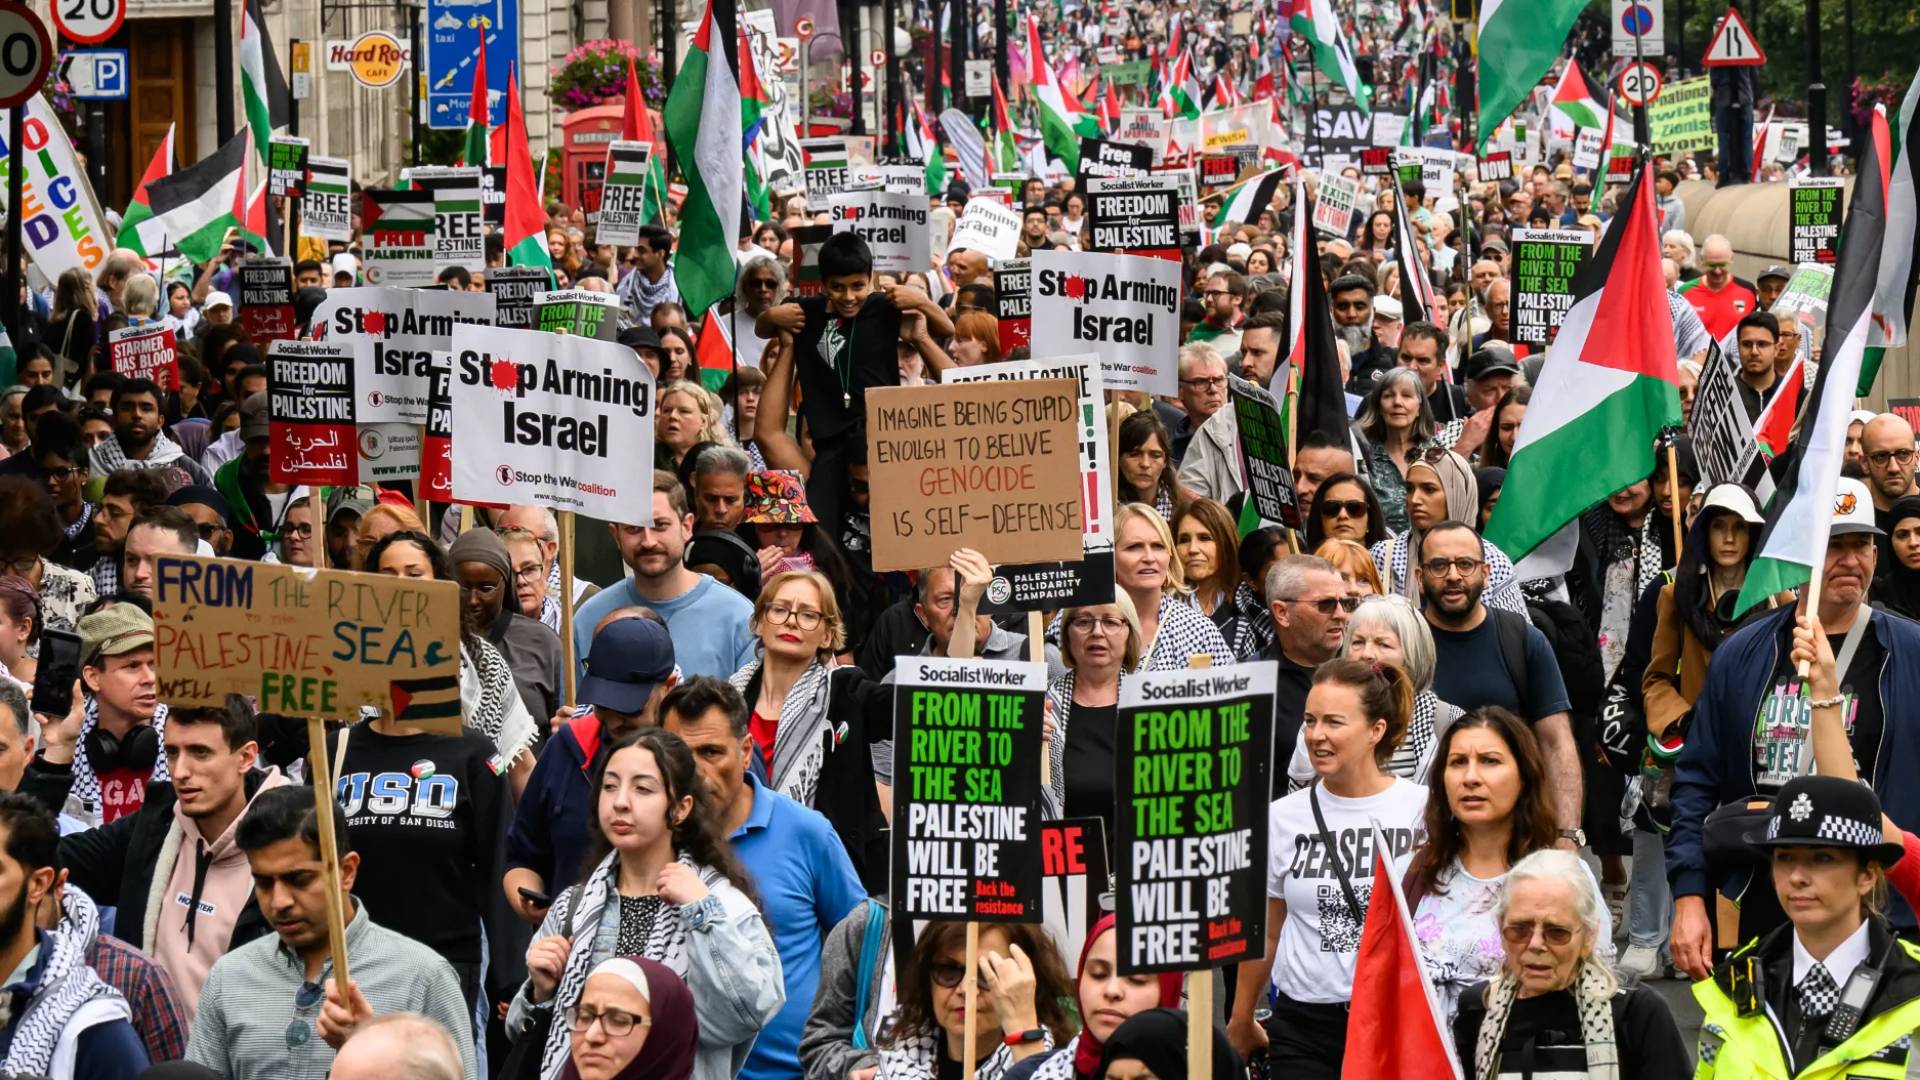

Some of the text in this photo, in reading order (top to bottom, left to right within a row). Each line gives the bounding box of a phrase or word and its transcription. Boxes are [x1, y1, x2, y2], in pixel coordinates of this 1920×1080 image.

[64, 0, 115, 20] 20
[434, 33, 455, 43] taxi
[330, 44, 411, 66] Hard Roc
[873, 51, 884, 65] D
[98, 61, 118, 88] P
[366, 68, 388, 77] CAFE
[1626, 75, 1656, 92] 20
[1312, 109, 1373, 139] SAV
[1206, 129, 1248, 147] JEWISH
[1100, 143, 1132, 163] Free
[1080, 157, 1148, 178] Palestine
[1204, 158, 1235, 175] FREE
[1479, 159, 1511, 181] NOW
[804, 168, 849, 187] FREE
[885, 174, 922, 186] Arming
[1100, 181, 1164, 190] Socialist Worker
[602, 186, 642, 212] FREE
[807, 186, 845, 196] PALESTIN
[1795, 188, 1837, 201] FROM THE
[304, 192, 348, 214] FREE
[1096, 194, 1169, 217] FREEDOM
[1795, 201, 1833, 213] RIVER TO
[303, 210, 348, 225] PALESTINE
[600, 211, 640, 225] PALESTINE
[868, 202, 926, 225] Arming
[970, 204, 1018, 231] Arming
[1128, 215, 1140, 226] for
[1795, 213, 1829, 226] THE SEA
[435, 213, 481, 238] REE
[1794, 224, 1838, 238] PALESTINE
[373, 229, 426, 248] FREE
[1094, 225, 1176, 248] PALESTINE
[1524, 231, 1582, 241] Socialist Worker
[1794, 238, 1828, 250] WILL BE
[365, 249, 434, 260] PALESTINE
[1520, 244, 1582, 261] FROM THE
[1794, 249, 1816, 262] FREE
[1003, 261, 1031, 270] Socialist
[1520, 260, 1576, 278] RIVER TO
[244, 269, 286, 284] FREEDOM
[1000, 272, 1031, 292] FREE
[1519, 276, 1569, 294] THE SEA
[243, 289, 290, 304] PALESTINE
[491, 281, 546, 300] FREEDOM
[545, 292, 607, 303] Socialist Worker
[1100, 273, 1178, 314] Arming
[1518, 292, 1576, 310] PALESTIN
[540, 303, 605, 322] FROM THE
[1517, 308, 1568, 326] WILL BE
[579, 321, 597, 338] TO
[1073, 307, 1154, 346] Israel
[1516, 325, 1547, 342] FREE
[114, 335, 165, 359] STARMER
[277, 343, 342, 357] Socialist Worker
[115, 347, 175, 373] HAS BLOOD
[373, 341, 432, 378] Isra
[1113, 362, 1158, 375] War coalition
[273, 359, 347, 386] FREEDOM
[302, 384, 316, 397] for
[541, 358, 650, 417] Arming
[271, 393, 353, 420] PALESTINE
[877, 395, 1073, 431] IMAGINE BEING STUPID
[503, 400, 609, 458] Israel
[285, 428, 339, 452] الحرية
[876, 429, 1053, 464] ENOUGH TO BELIVE
[281, 451, 349, 473] لفلسطين
[515, 471, 617, 498] Stop the War coalition
[919, 464, 1036, 497] GENOCIDE
[1252, 475, 1294, 507] WILL BE
[892, 500, 1081, 537] IS SELF-DEFENSE
[1256, 495, 1284, 522] FREE
[1014, 569, 1075, 583] PALESTINE
[1014, 578, 1081, 592] SOLIDARITY
[156, 558, 432, 629] FROM THE RIVER
[992, 585, 1006, 595] PSC
[1015, 588, 1074, 601] CAMPAIGN
[155, 621, 418, 671] PALESTINE SEA
[919, 664, 1027, 687] Socialist Worker
[157, 671, 338, 713] WILL FREE
[1141, 673, 1251, 701] Socialist Worker
[912, 691, 1026, 730] FROM THE
[1133, 702, 1252, 752] FROM THE
[911, 728, 1013, 767] RIVER TO
[1133, 746, 1243, 795] RIVER TO
[909, 765, 1003, 802] THE SEA
[337, 772, 459, 819] USD
[381, 816, 396, 825] OF
[399, 817, 422, 826] SAN
[908, 802, 1028, 842] PALESTINE
[1132, 790, 1234, 838] THE SEA
[907, 840, 968, 877] WILL
[974, 842, 1000, 878] BE
[1132, 828, 1252, 881] PALESTINE
[906, 876, 968, 914] FREE
[975, 879, 1016, 898] Back the
[178, 894, 214, 914] HOTER
[975, 900, 1025, 916] resistance
[1131, 875, 1231, 924] WILL BE
[1131, 922, 1200, 967] FREE
